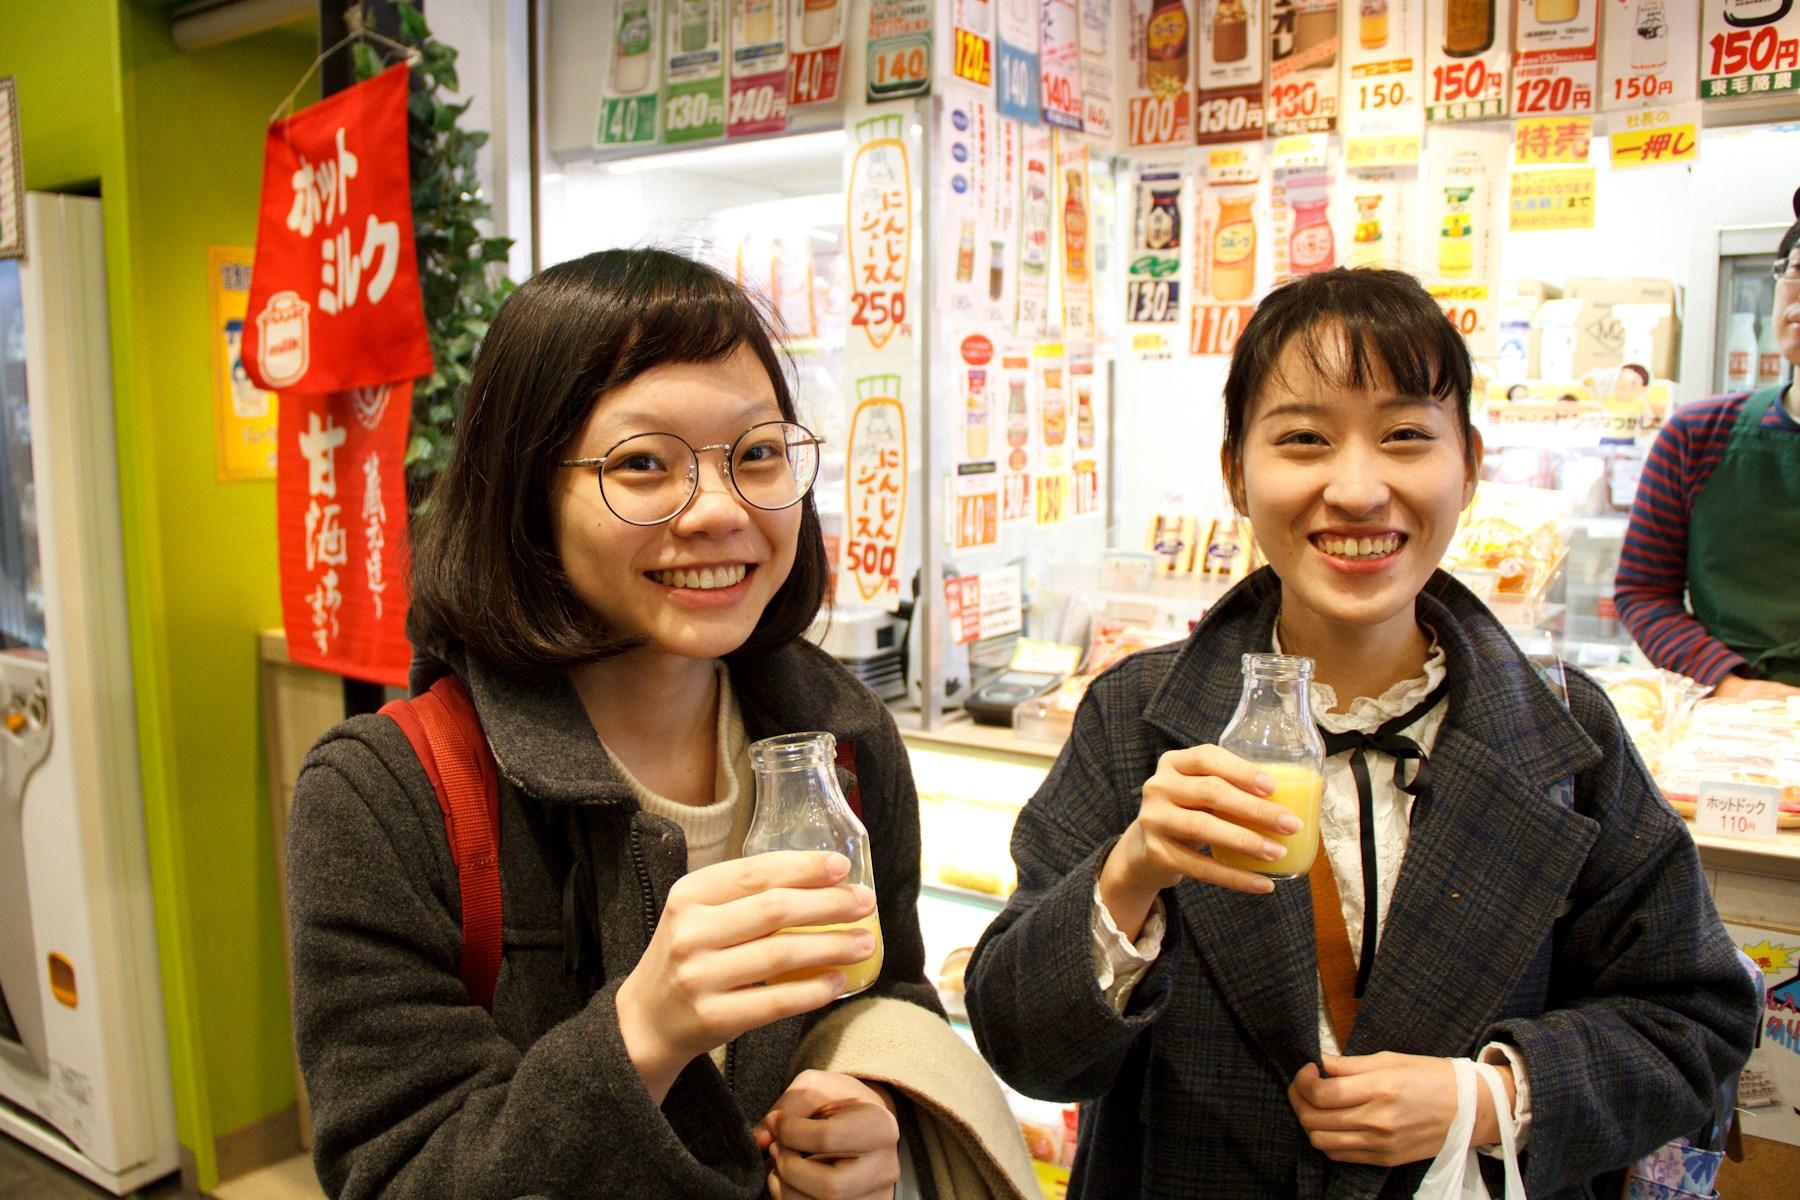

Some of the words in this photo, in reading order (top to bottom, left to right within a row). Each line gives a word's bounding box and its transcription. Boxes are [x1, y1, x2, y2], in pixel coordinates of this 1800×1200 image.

[1709, 26, 1799, 76] 150円
[1271, 81, 1335, 118] 130円
[1434, 60, 1502, 102] 150円
[1516, 76, 1591, 112] 120円
[1614, 75, 1673, 100] 150円
[1710, 72, 1791, 95] 東毛酪農
[665, 92, 724, 130] 130円
[731, 85, 787, 125] 140円
[1198, 97, 1262, 133] 130円
[1517, 122, 1591, 160] 特売
[1616, 131, 1695, 161] 一押し
[286, 126, 358, 238] ホット
[882, 191, 904, 282] にんじん
[317, 214, 400, 316] ミルク
[876, 448, 899, 540] にんじん
